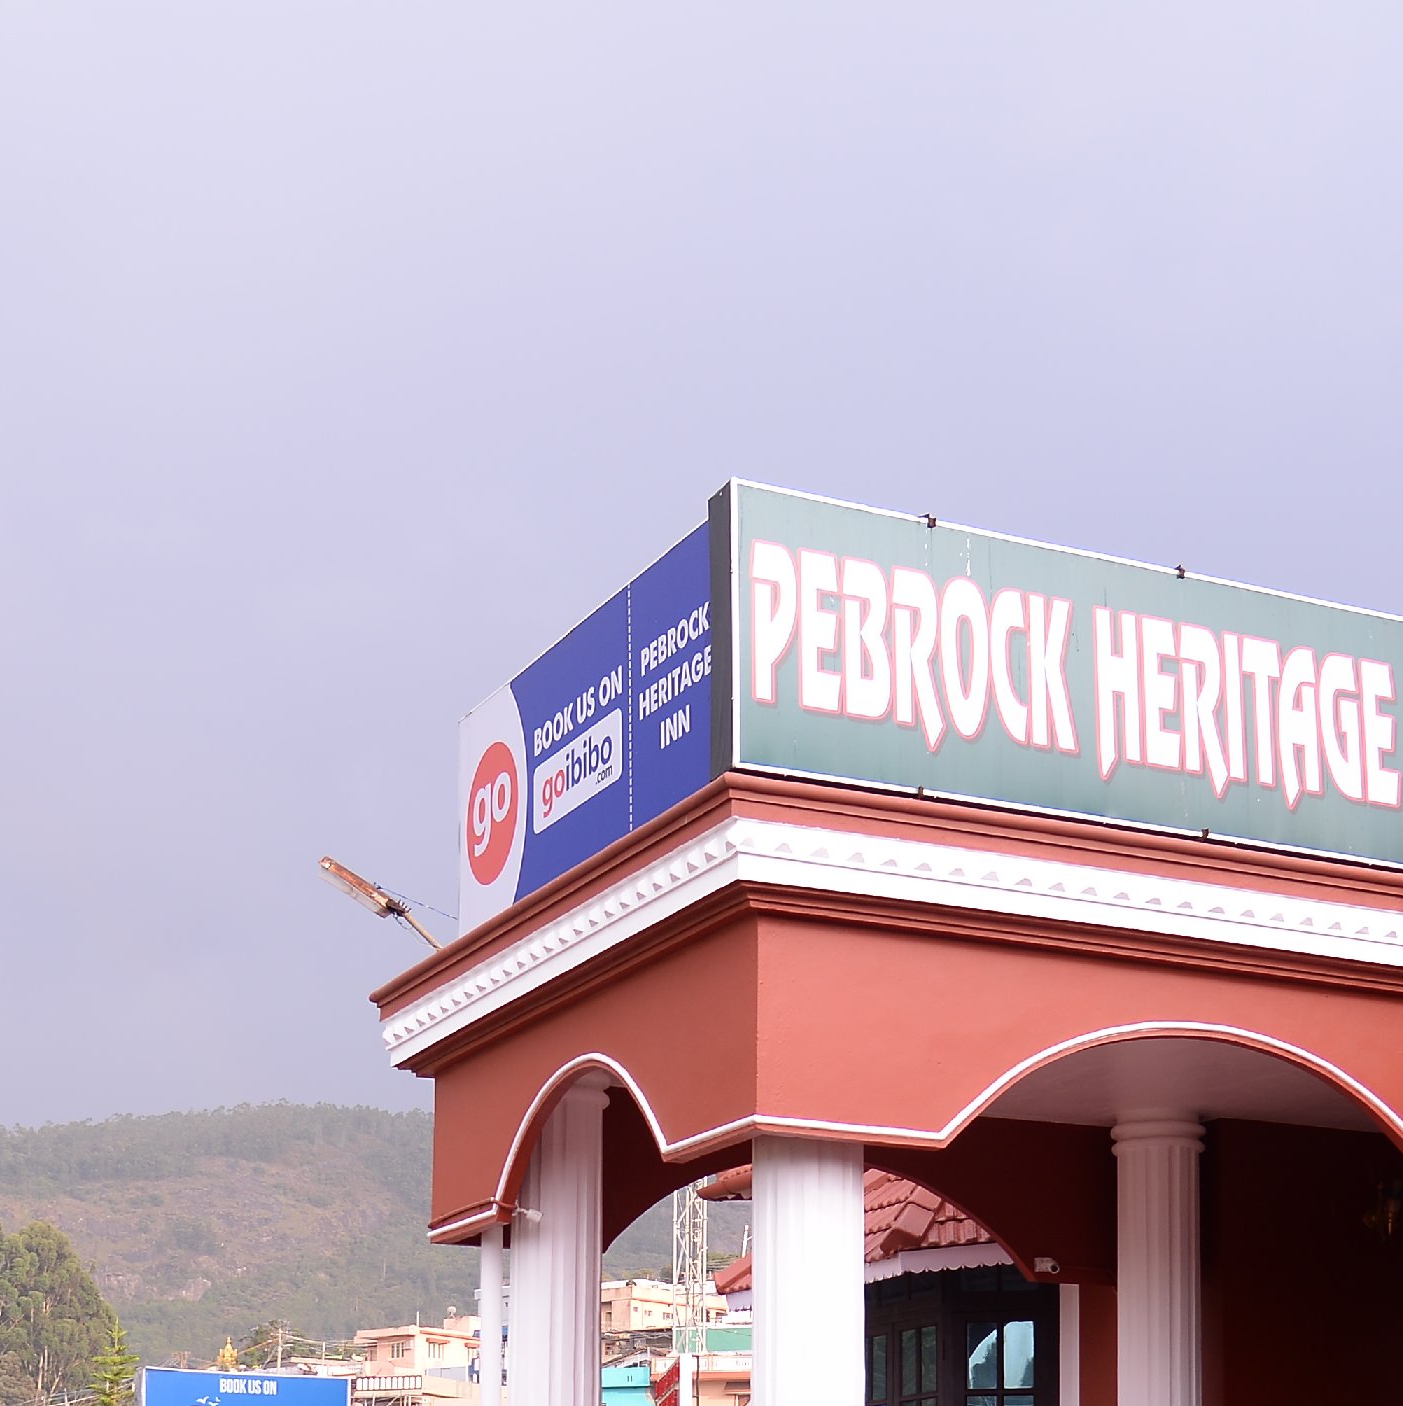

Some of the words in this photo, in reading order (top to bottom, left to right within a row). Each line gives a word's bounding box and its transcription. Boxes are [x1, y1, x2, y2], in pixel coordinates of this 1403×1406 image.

[640, 601, 711, 677] PEBROCK
[749, 538, 1080, 754] PEBROCK
[1093, 605, 1402, 811] HERITAGE
[533, 703, 574, 757] BOOK
[577, 685, 595, 724] US
[599, 665, 623, 707] ON
[639, 645, 712, 721] HERITAGE
[660, 704, 691, 749] INN
[473, 772, 511, 858] go
[542, 735, 613, 818] goibibo
[219, 1378, 247, 1394] BOOK
[248, 1380, 262, 1395] US
[262, 1380, 277, 1396] ON
